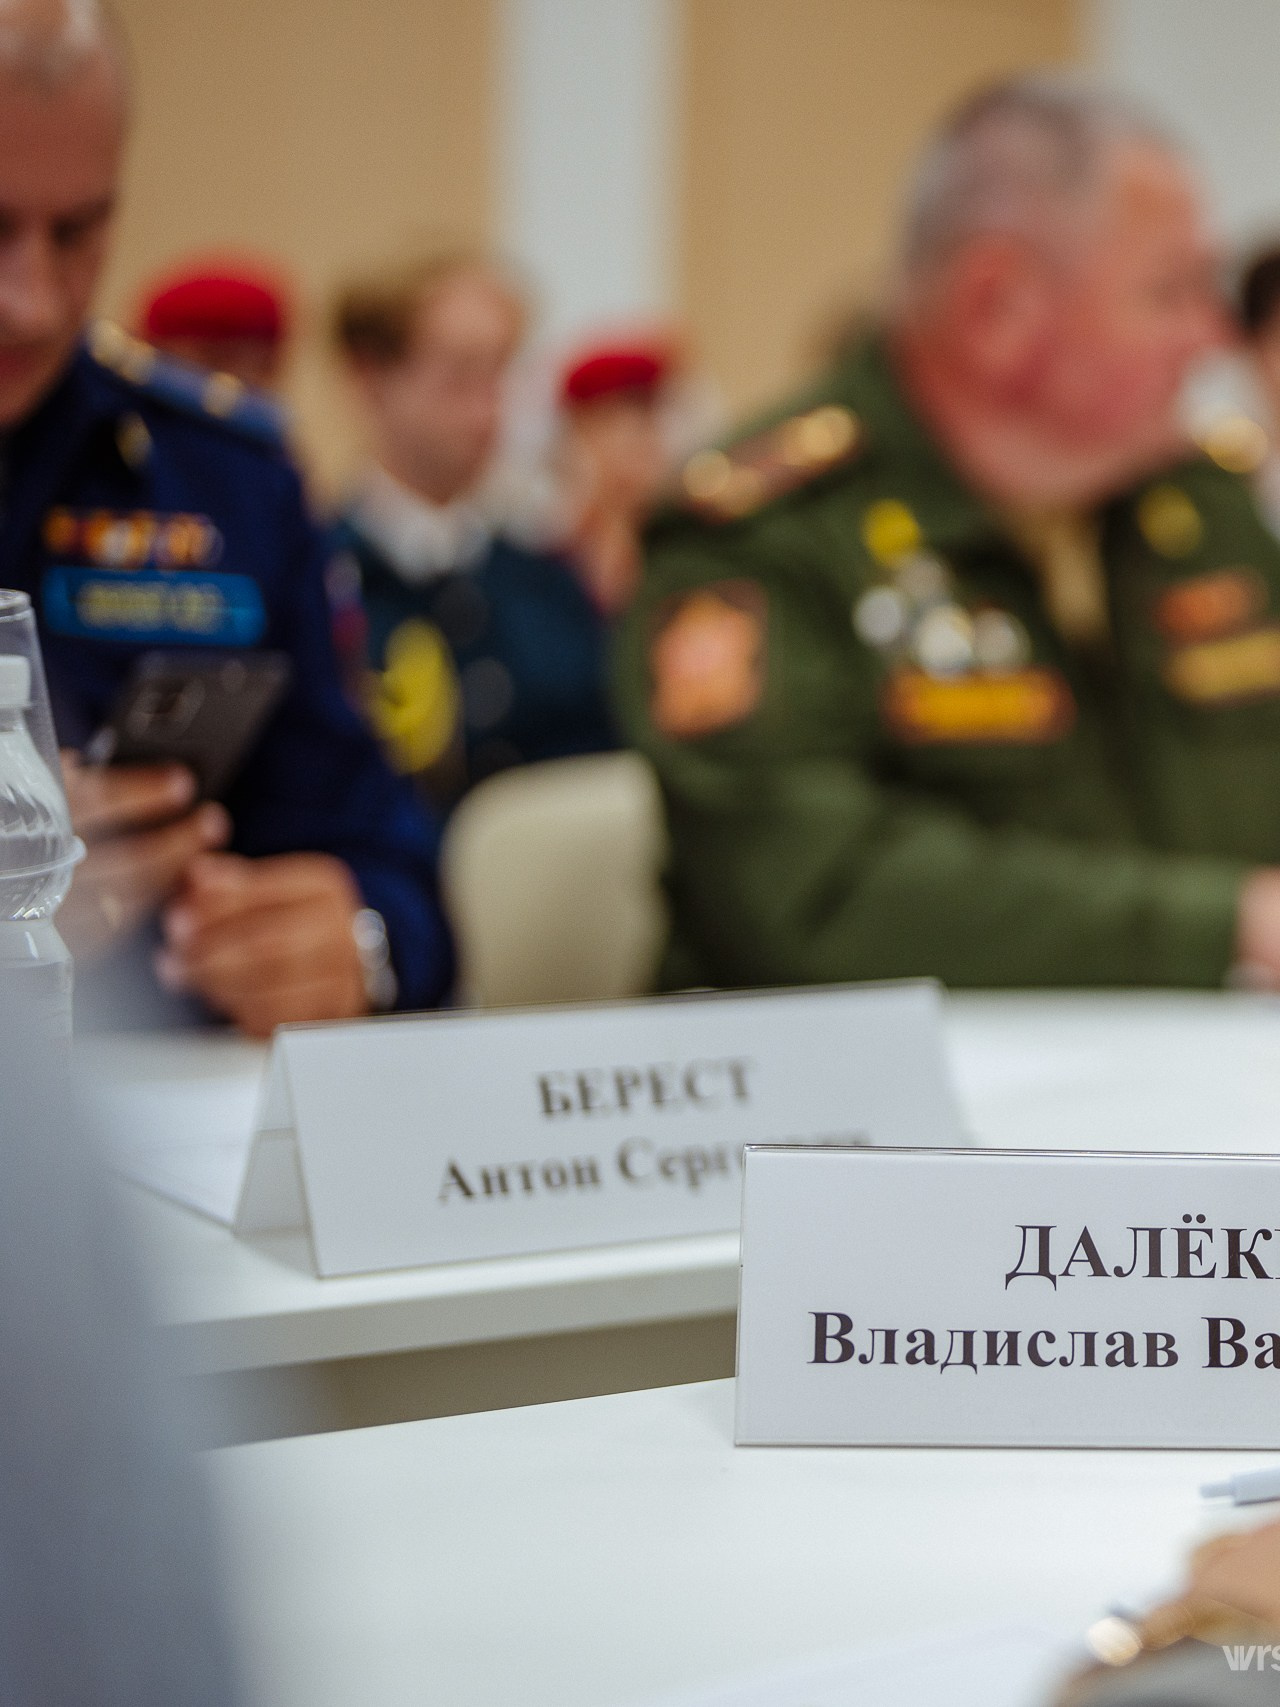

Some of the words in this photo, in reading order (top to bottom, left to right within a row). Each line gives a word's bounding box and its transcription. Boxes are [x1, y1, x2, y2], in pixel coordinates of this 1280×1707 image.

[535, 1057, 755, 1120] БЕРЕСТ
[438, 1156, 603, 1205] Антон
[806, 1311, 1179, 1376] Владислав
